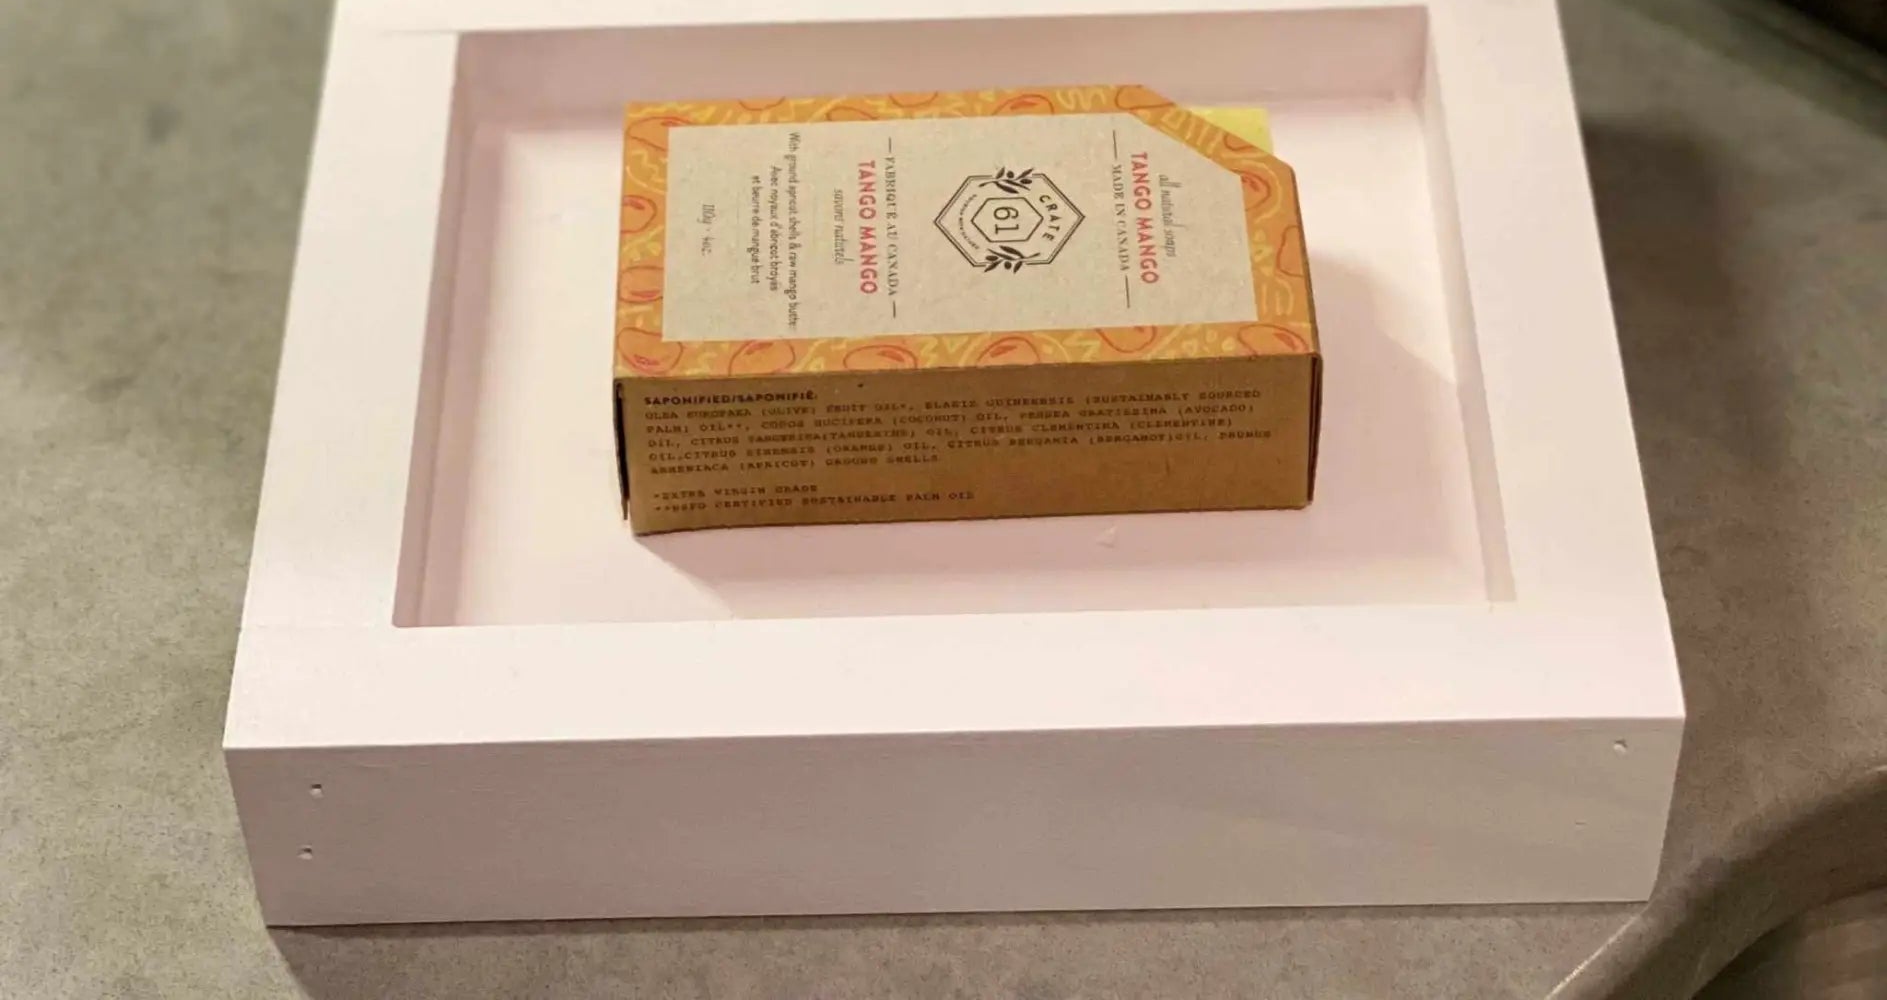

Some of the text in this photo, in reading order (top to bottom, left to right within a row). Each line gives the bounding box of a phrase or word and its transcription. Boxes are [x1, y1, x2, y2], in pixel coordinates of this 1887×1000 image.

[789, 132, 800, 152] With
[784, 154, 799, 183] ground
[768, 189, 779, 220] noyaux
[786, 186, 799, 212] apricot
[747, 175, 762, 284] et beurre de mangue brut
[788, 213, 800, 240] shells
[834, 189, 855, 266] savons naturels
[858, 160, 878, 295] TANGO MANGO
[993, 206, 1019, 235] 61
[1038, 194, 1062, 242] CRATE
[1112, 164, 1130, 271] MADE IN CANADA
[1131, 152, 1160, 284] TANGO MANGO
[1158, 174, 1187, 257] all natural soaps
[886, 224, 898, 240] AU
[789, 252, 798, 268] raw
[887, 243, 900, 297] CANADA
[784, 270, 798, 300] mango
[1086, 392, 1190, 404] (SUSTAINABLY
[1200, 390, 1262, 400] SOURCED
[892, 414, 967, 425] (COCONUT)
[1178, 404, 1254, 416] (AVOCADO)
[690, 436, 740, 446] CITRUS
[714, 486, 766, 496] VIRGIN
[715, 498, 793, 510] CERTIFIED
[906, 492, 940, 502] PALM
[948, 491, 975, 500] OIL
